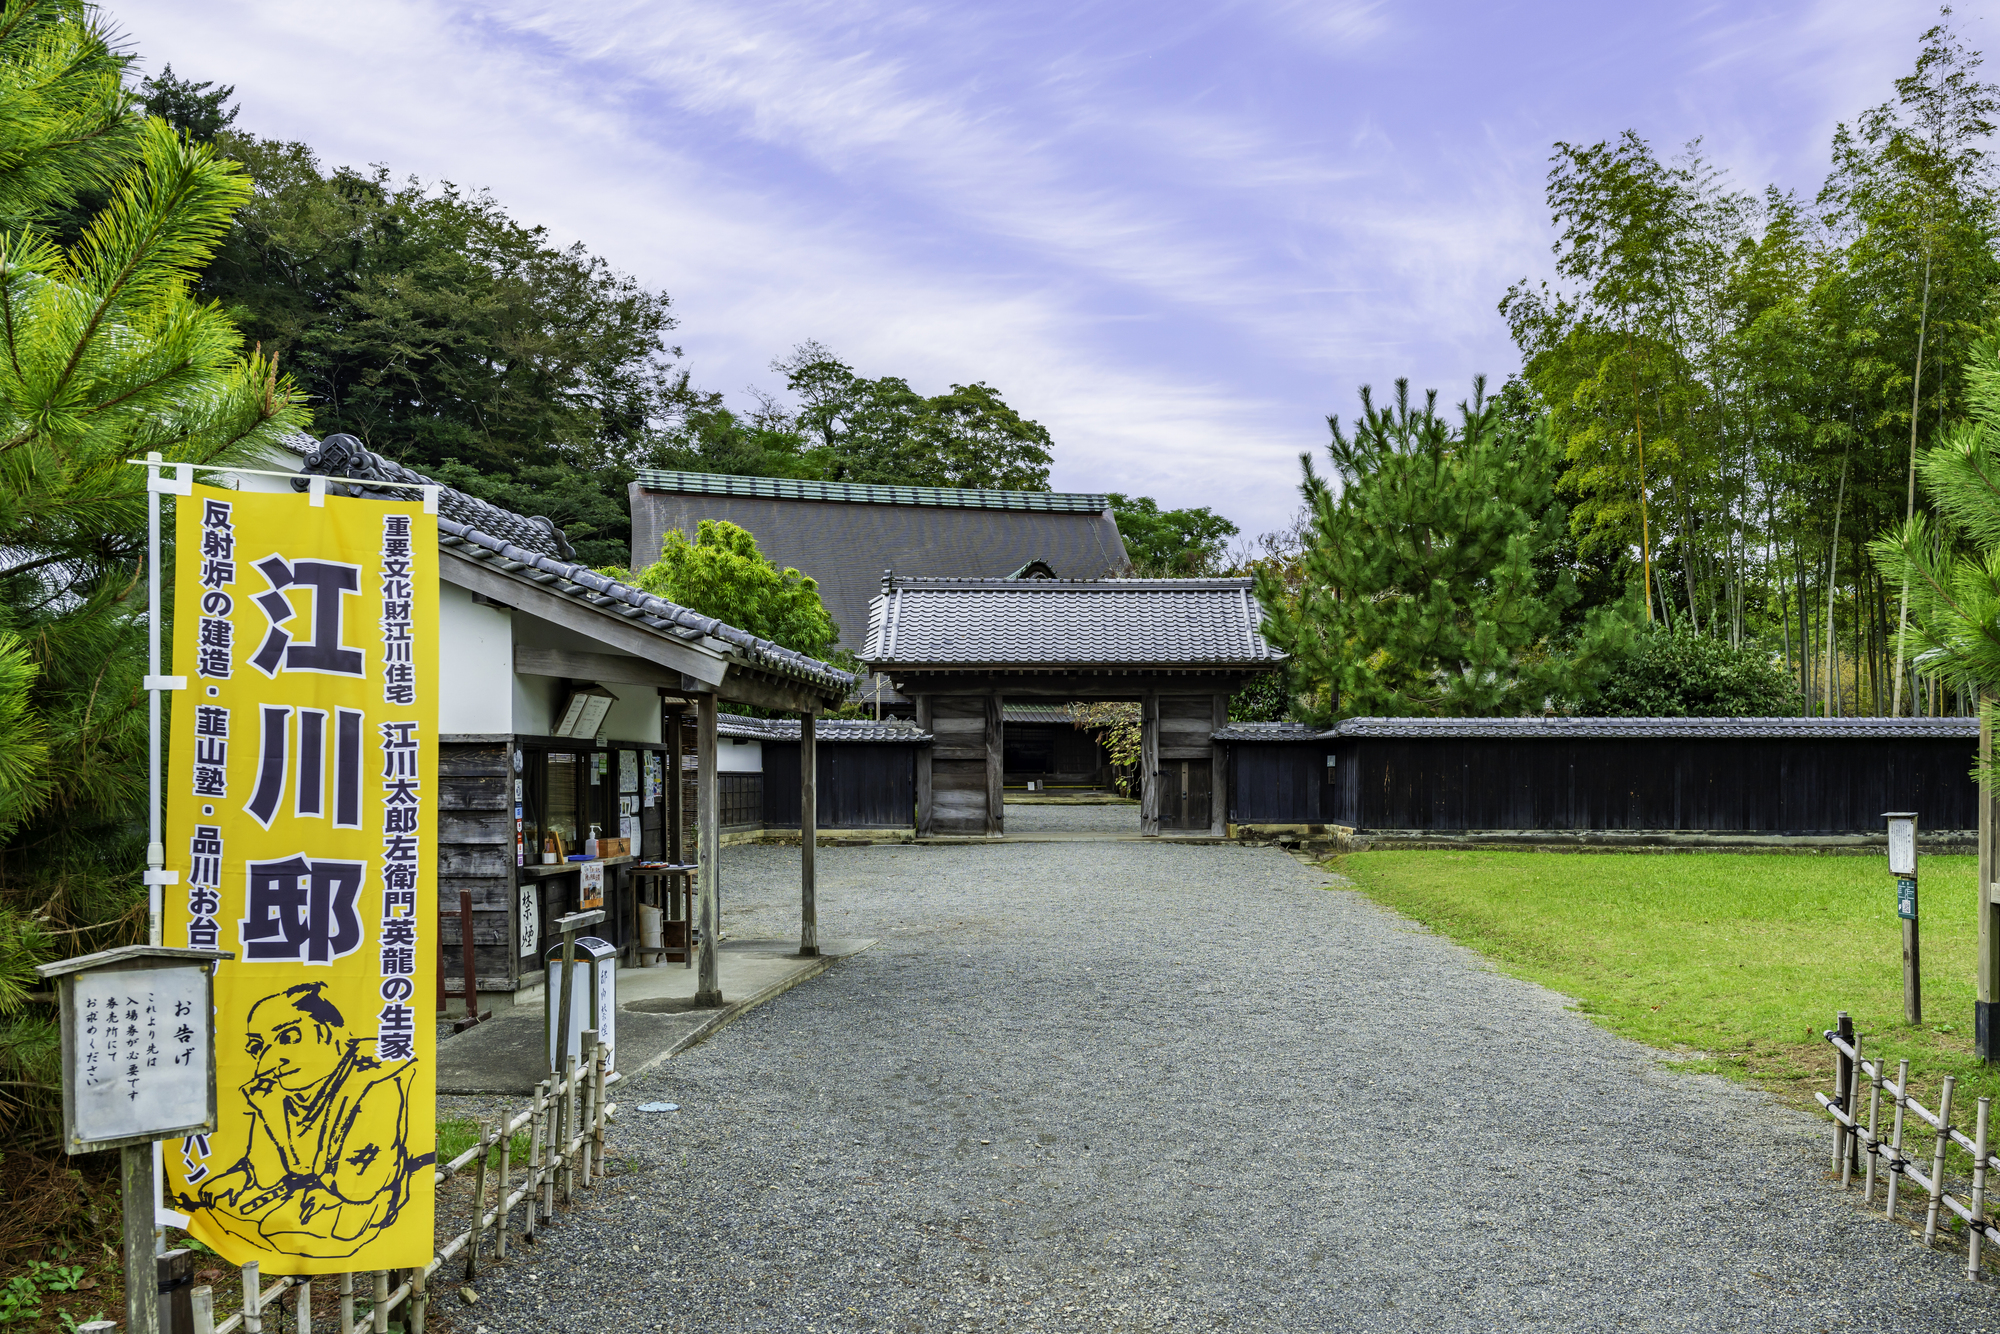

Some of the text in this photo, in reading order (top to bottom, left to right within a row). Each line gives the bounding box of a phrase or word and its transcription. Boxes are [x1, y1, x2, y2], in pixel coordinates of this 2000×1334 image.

[242, 551, 367, 966] 江川邸
[375, 513, 421, 1062] 重要文化財江川住宅 江川太郎左衛門英龍の生家
[521, 890, 535, 948] 禁煙
[86, 998, 99, 1086] お求めください
[105, 996, 119, 1062] 券売所にて
[125, 996, 140, 1102] 入場券が必要です
[146, 992, 159, 1067] これより先は
[173, 1000, 195, 1067] お告げ
